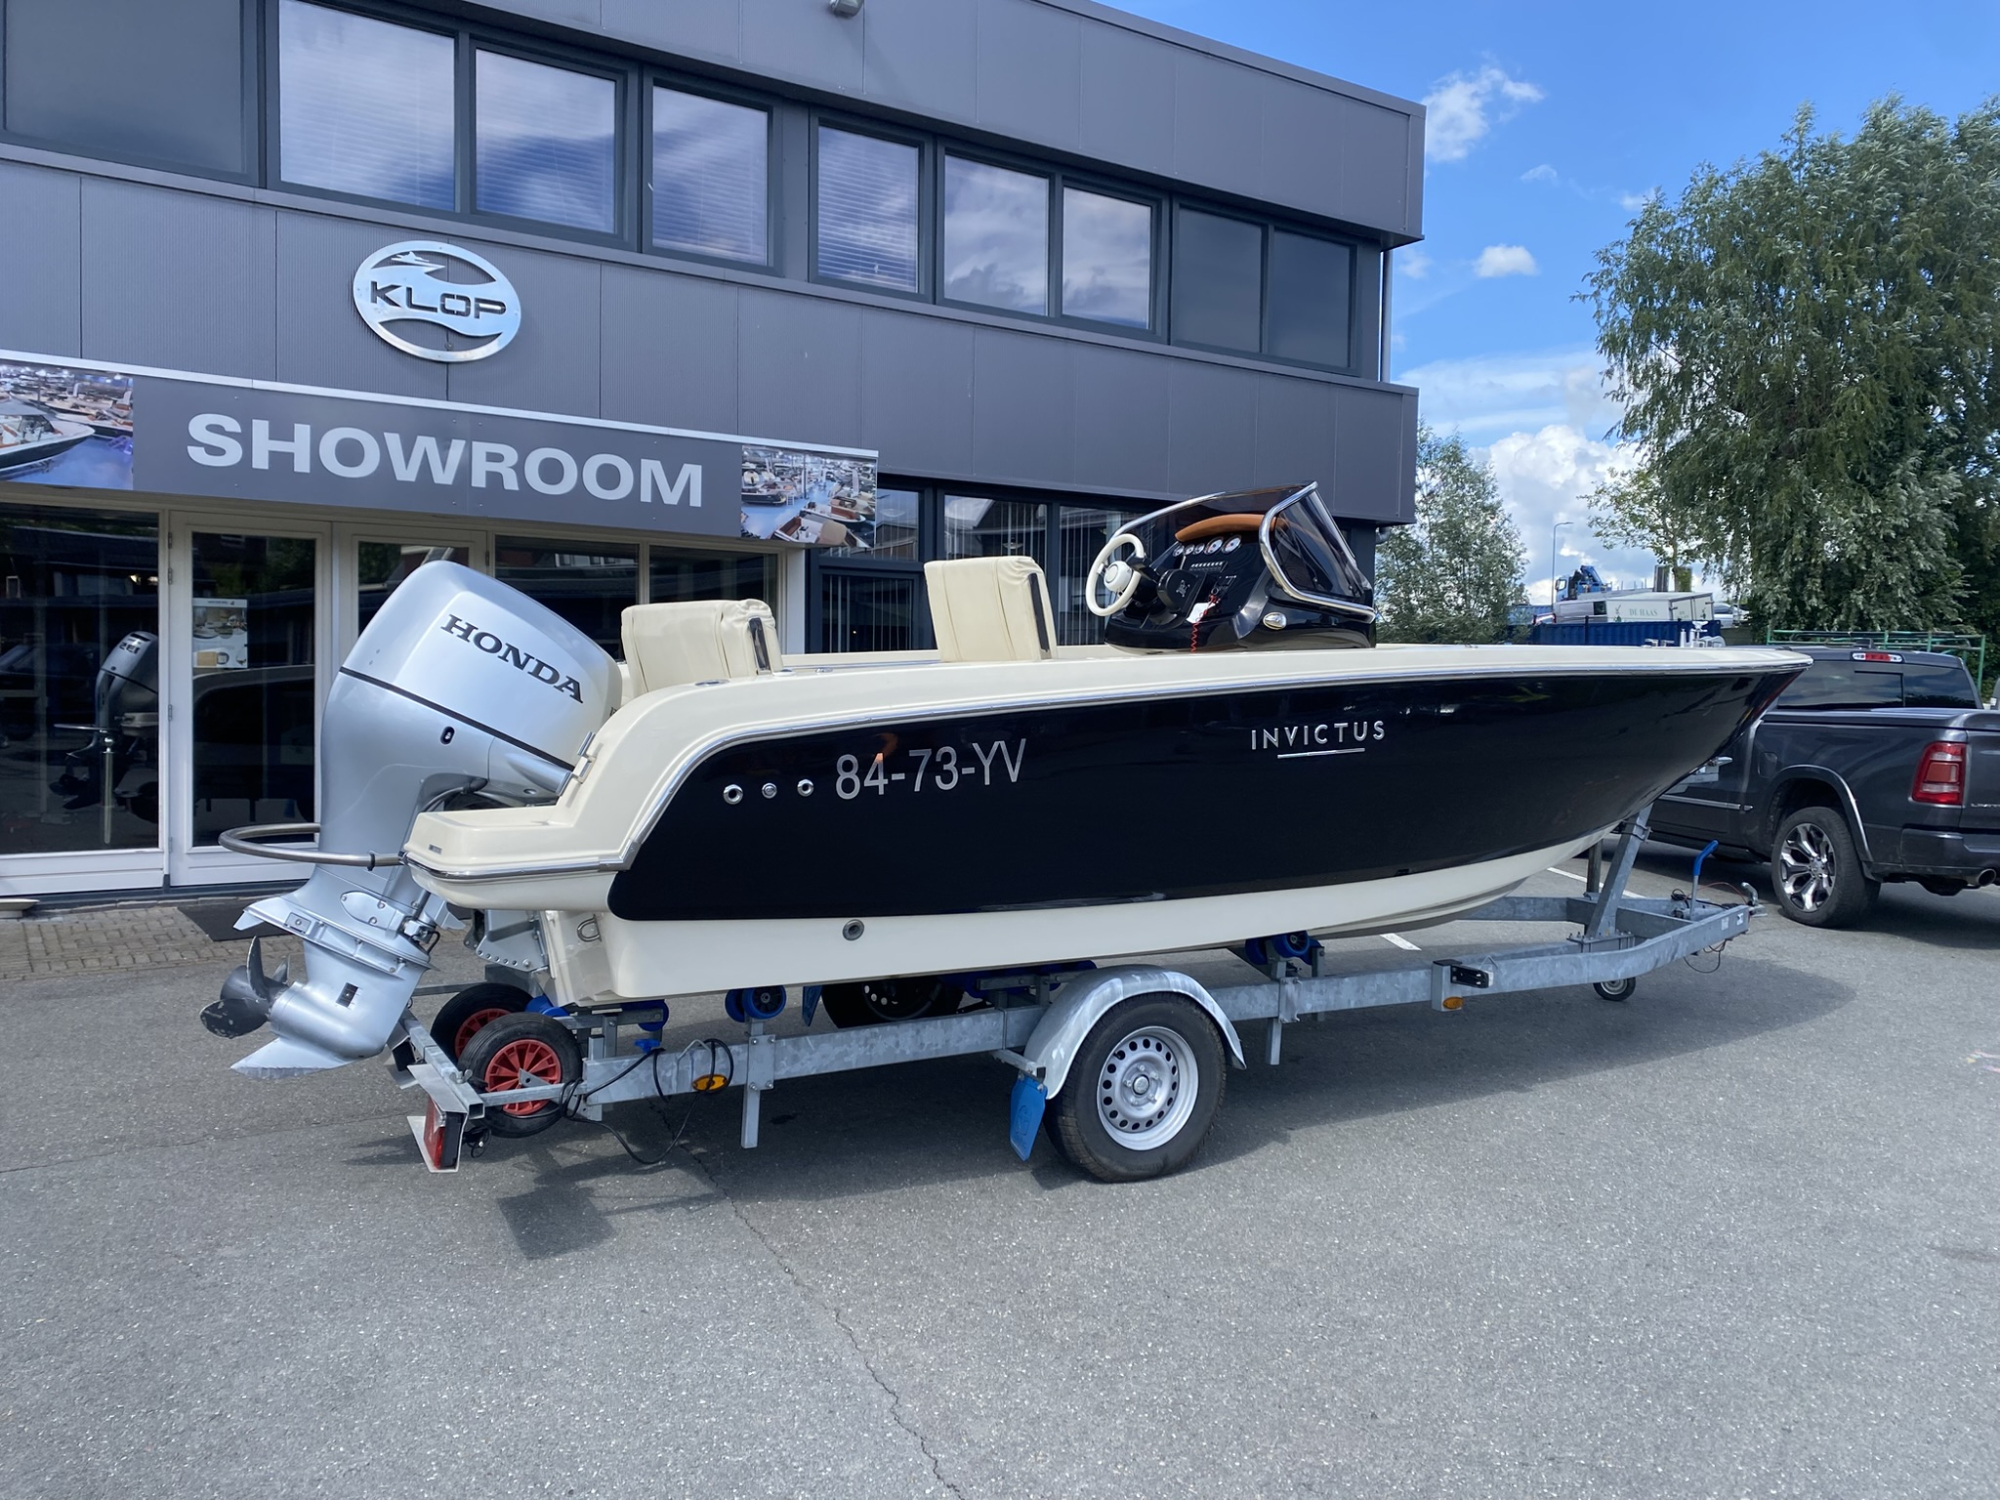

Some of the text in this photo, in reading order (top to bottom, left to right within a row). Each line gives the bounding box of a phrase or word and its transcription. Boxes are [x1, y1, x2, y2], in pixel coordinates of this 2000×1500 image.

[370, 281, 507, 319] KLOP
[187, 413, 703, 507] SHOWROOM
[440, 613, 584, 704] HONDA
[1251, 720, 1385, 751] INVICTUS
[835, 738, 1027, 800] 84-73-YV
